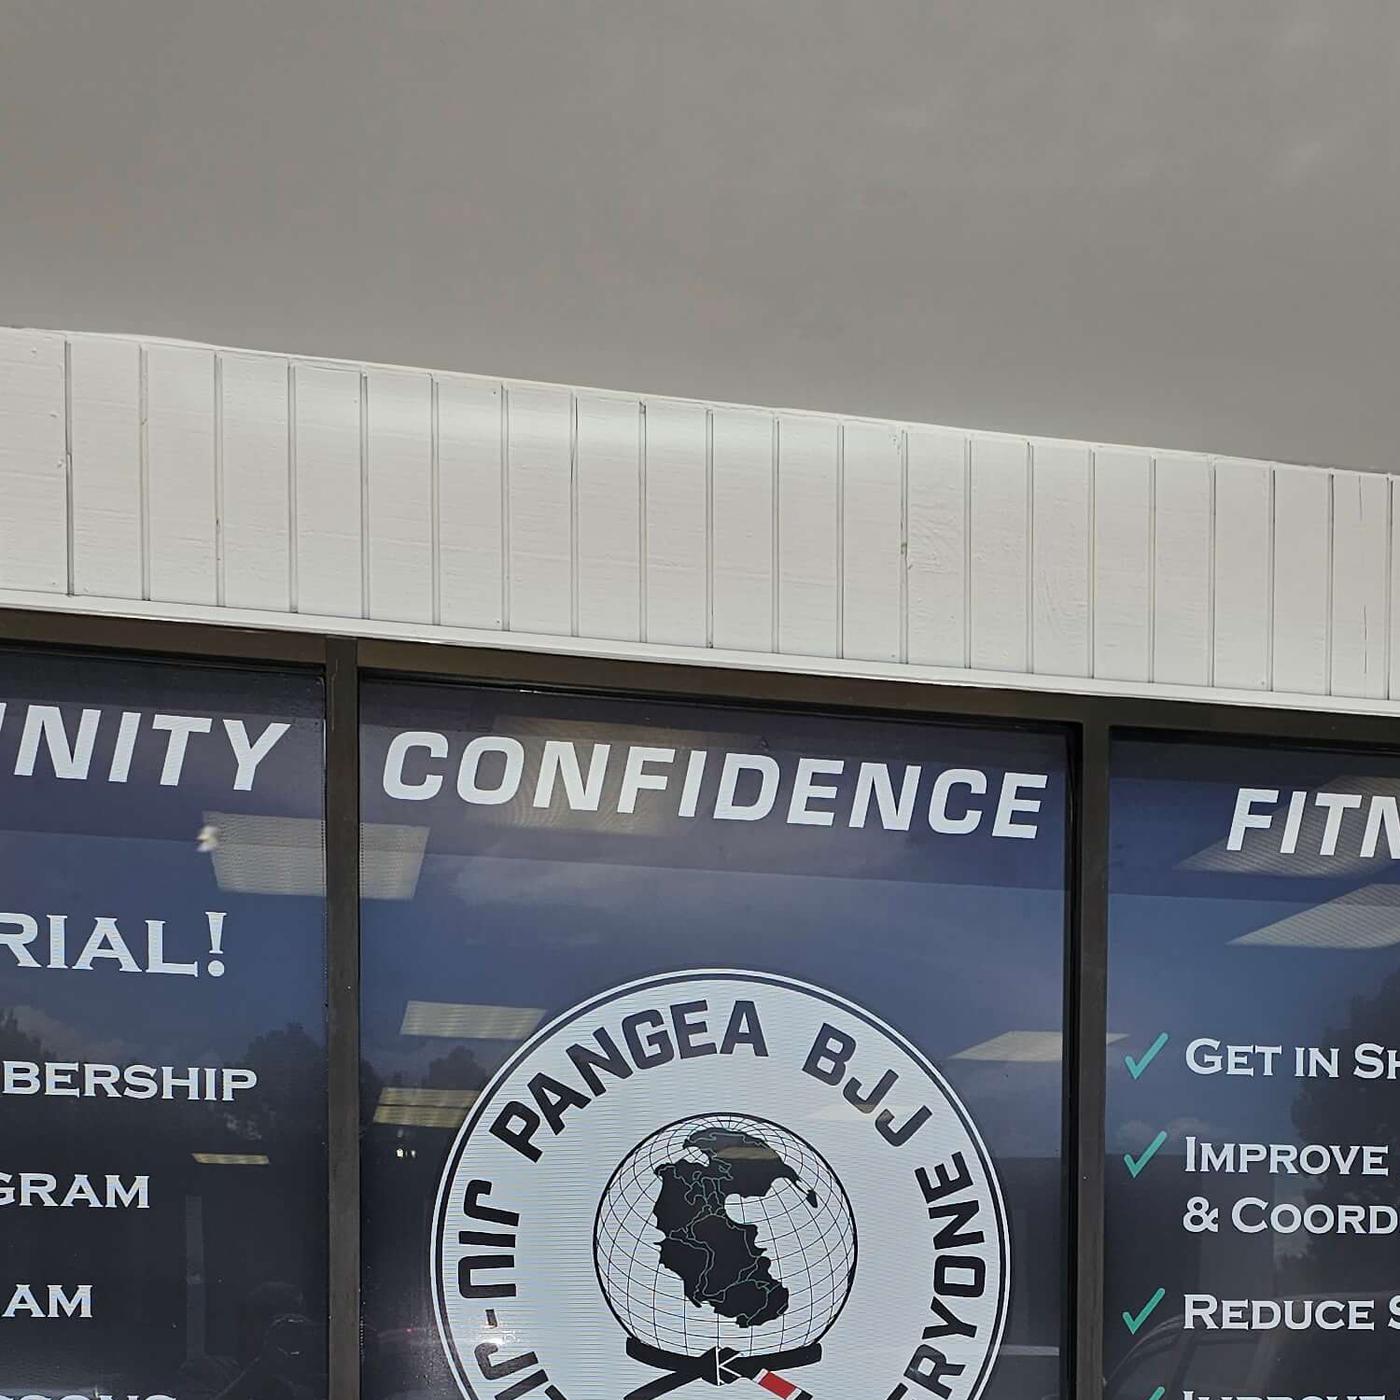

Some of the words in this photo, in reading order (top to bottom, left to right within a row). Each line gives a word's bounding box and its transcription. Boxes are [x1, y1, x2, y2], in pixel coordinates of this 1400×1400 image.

[0, 703, 291, 791] NITY
[382, 731, 1048, 840] CONFIDENCE
[1185, 1038, 1283, 1077] GET
[1295, 1045, 1339, 1079] IN
[2, 1060, 257, 1101] BERSHIP
[488, 999, 769, 1163] PANGEA
[801, 1022, 932, 1148] BJJ
[1184, 1136, 1389, 1177] IMPROVE
[1182, 1197, 1219, 1233] &
[2, 1284, 93, 1318] AM
[1183, 1294, 1375, 1331] REDUCE
